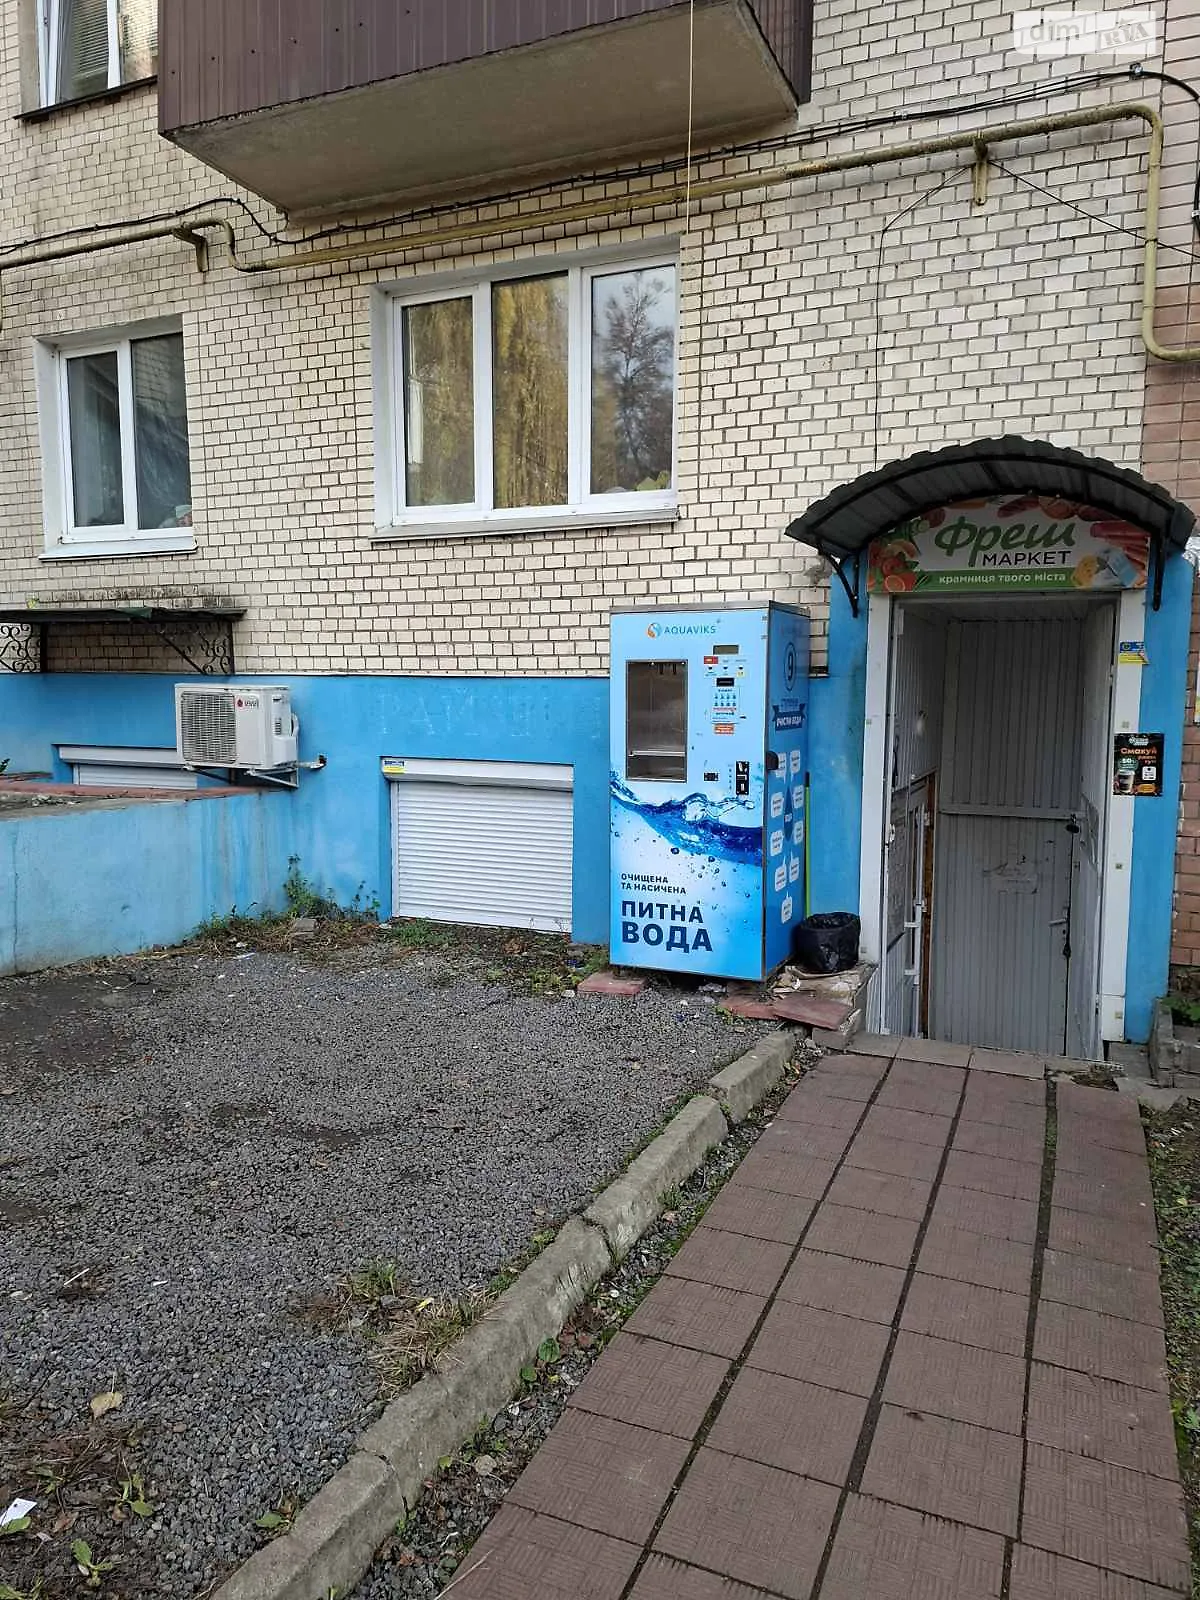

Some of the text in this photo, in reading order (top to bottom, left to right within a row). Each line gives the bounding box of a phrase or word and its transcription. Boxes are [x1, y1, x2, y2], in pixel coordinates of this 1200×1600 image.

[934, 516, 1076, 568] Фреш
[982, 550, 1072, 566] МАРКЕТ
[938, 571, 1067, 585] крамниця твого міста
[621, 873, 669, 884] ОЧИЩЕНА
[621, 882, 687, 894] ТА НАСИЧЕНА
[621, 900, 704, 923] ПИТНА
[621, 921, 713, 954] ВОДА
